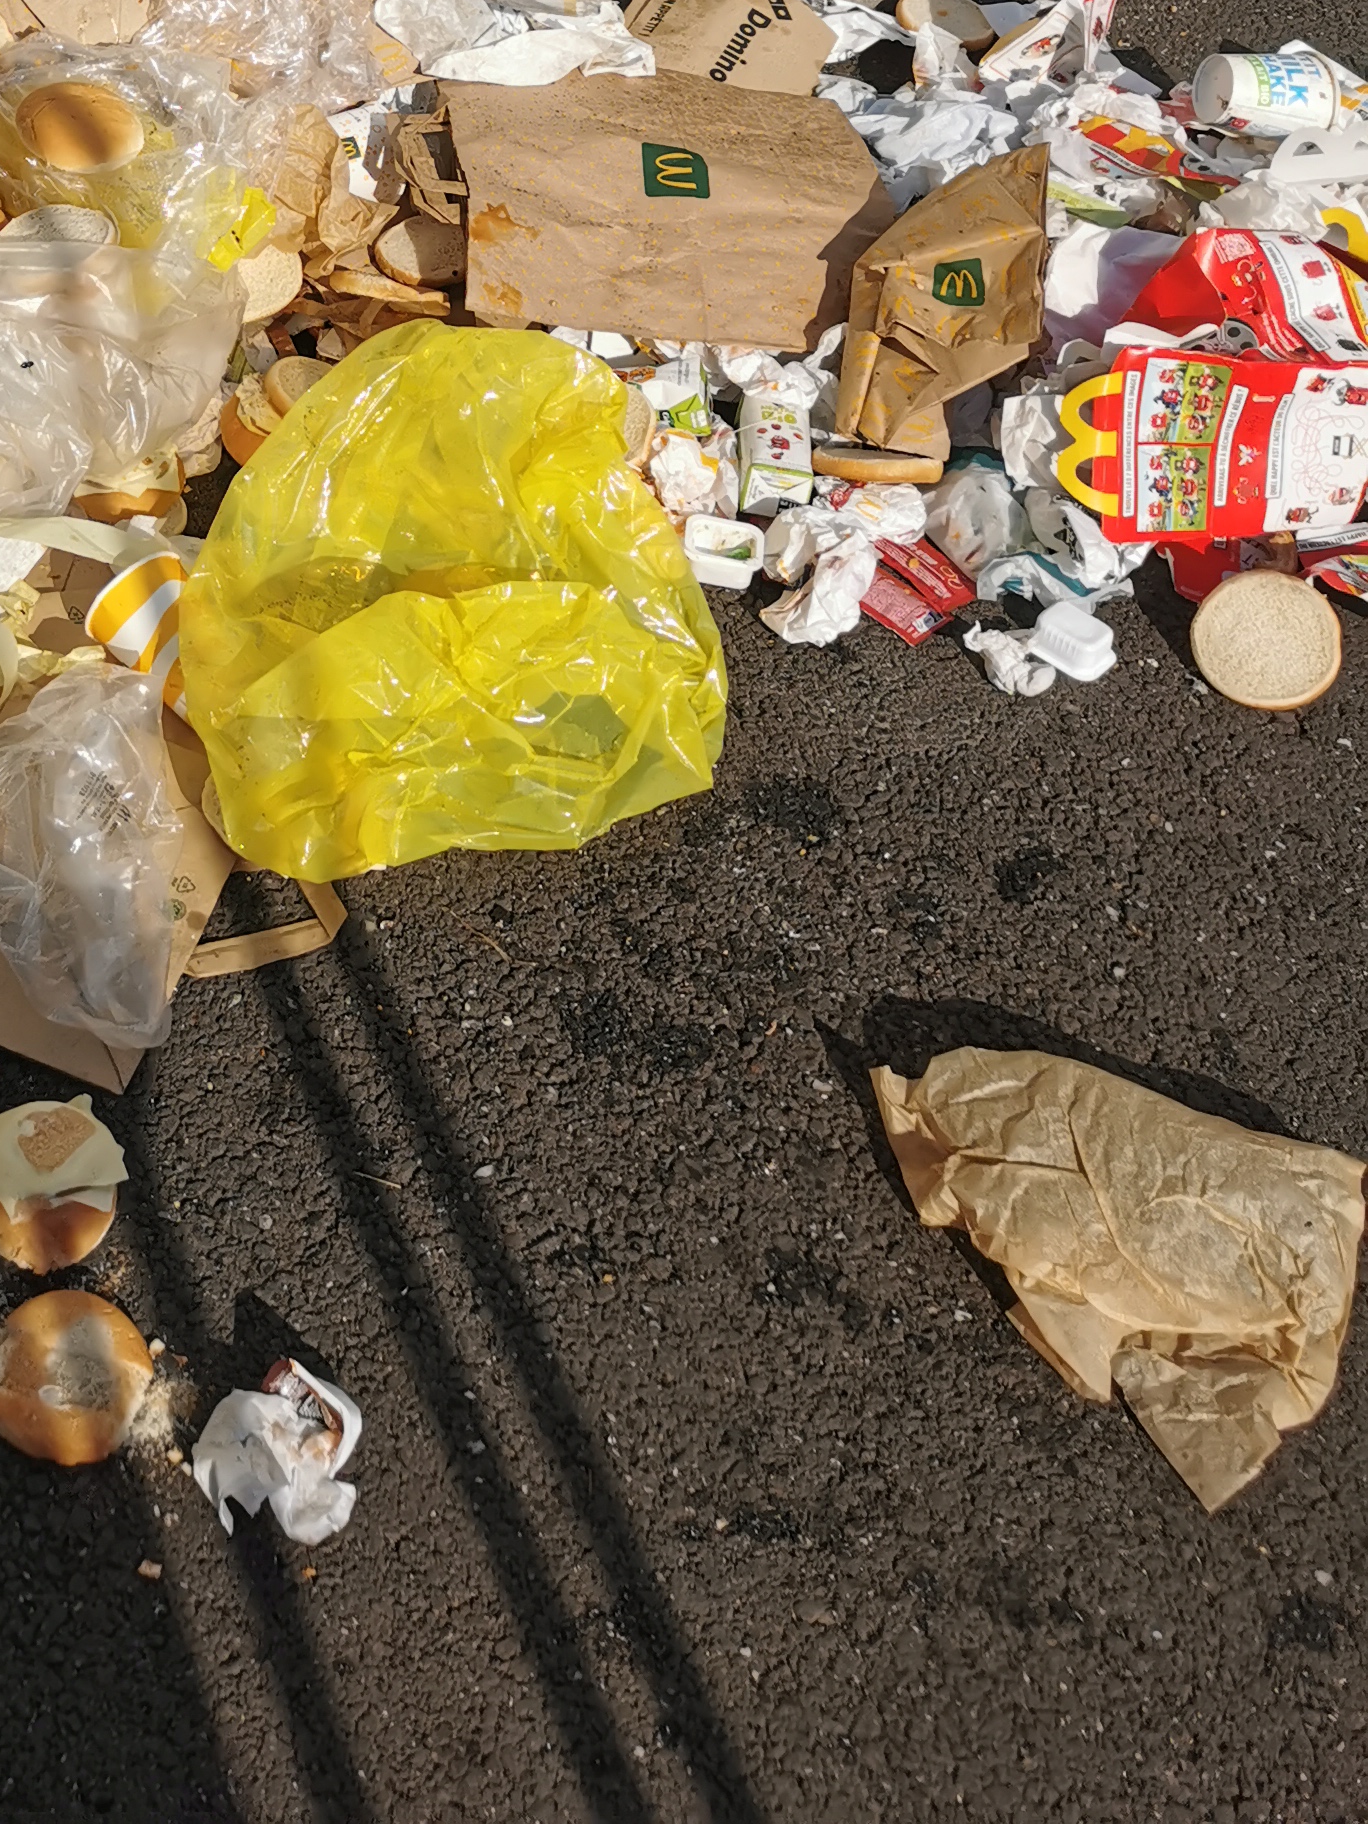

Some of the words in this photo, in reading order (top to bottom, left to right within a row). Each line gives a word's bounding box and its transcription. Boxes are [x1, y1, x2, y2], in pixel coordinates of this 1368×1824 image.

[1299, 56, 1322, 79] TIT
[1262, 56, 1287, 107] HAKE
[1260, 84, 1270, 105] BIO
[1127, 374, 1138, 396] IMAGES
[1126, 397, 1134, 410] CES
[1125, 411, 1133, 430] ENTRE
[1271, 447, 1279, 459] EST
[1270, 459, 1279, 480] HAPPY
[1269, 480, 1278, 496] QUEL
[1123, 490, 1131, 514] TROUVE
